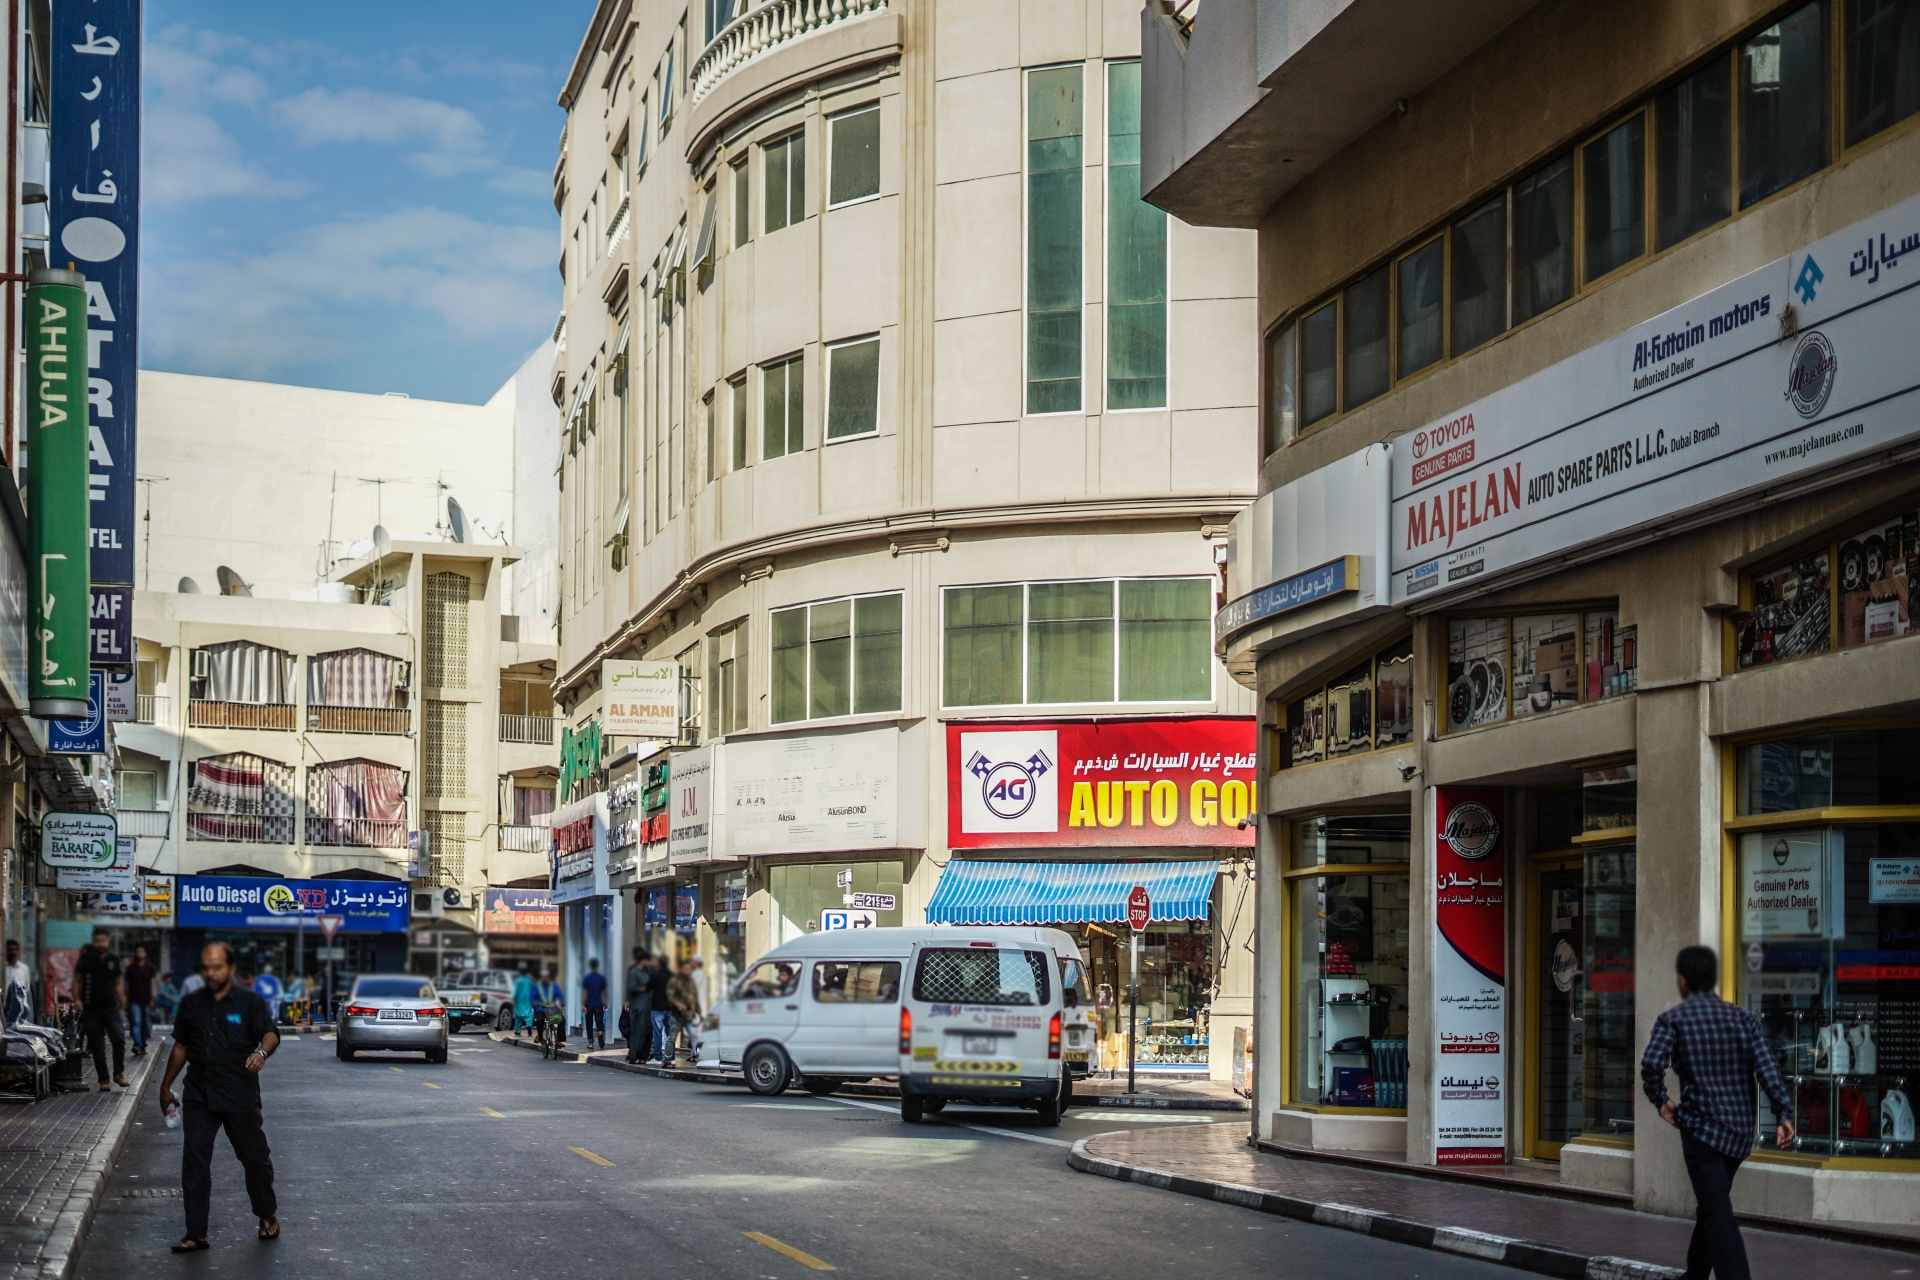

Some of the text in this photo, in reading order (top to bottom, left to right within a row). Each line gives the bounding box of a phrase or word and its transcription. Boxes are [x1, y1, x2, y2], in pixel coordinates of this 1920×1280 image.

[1633, 294, 1770, 372] Al-Futtaim motors
[39, 298, 67, 429] AHUJA
[1633, 356, 1694, 392] Authorized Dealer
[1783, 355, 1837, 396] Majelan
[1429, 413, 1475, 449] TOYOTA
[1765, 422, 1864, 465] www.majelanuae.com
[1415, 444, 1472, 480] GENUINE PARTS
[1406, 421, 1720, 551] MAJELAN AUTO SPARE PARTS L.L.C. Dubai Branch
[1456, 545, 1485, 561] INFINITI
[1415, 561, 1439, 579] NISSAN
[1449, 561, 1483, 578] GENUINE PARTS
[609, 704, 674, 718] AL AMANI
[1124, 752, 1189, 773] السيارات
[1190, 752, 1221, 771] غيار
[989, 778, 1028, 801] AG
[828, 805, 867, 816] AlusunBOND
[1069, 779, 1178, 827] AUTO
[1438, 821, 1500, 840] Majelan
[52, 842, 94, 855] BARARI
[1437, 871, 1503, 890] ماجلان
[1754, 878, 1809, 893] Genuine Parts
[181, 885, 214, 903] Auto
[217, 885, 261, 904] Diesel
[865, 895, 875, 907] 21
[1132, 892, 1147, 907] قف
[1748, 894, 1817, 909] Authorized Dealer
[829, 914, 845, 930] P
[1130, 909, 1147, 921] STOP
[1440, 1031, 1483, 1043] تويوتا
[1440, 1075, 1484, 1090] نيسان
